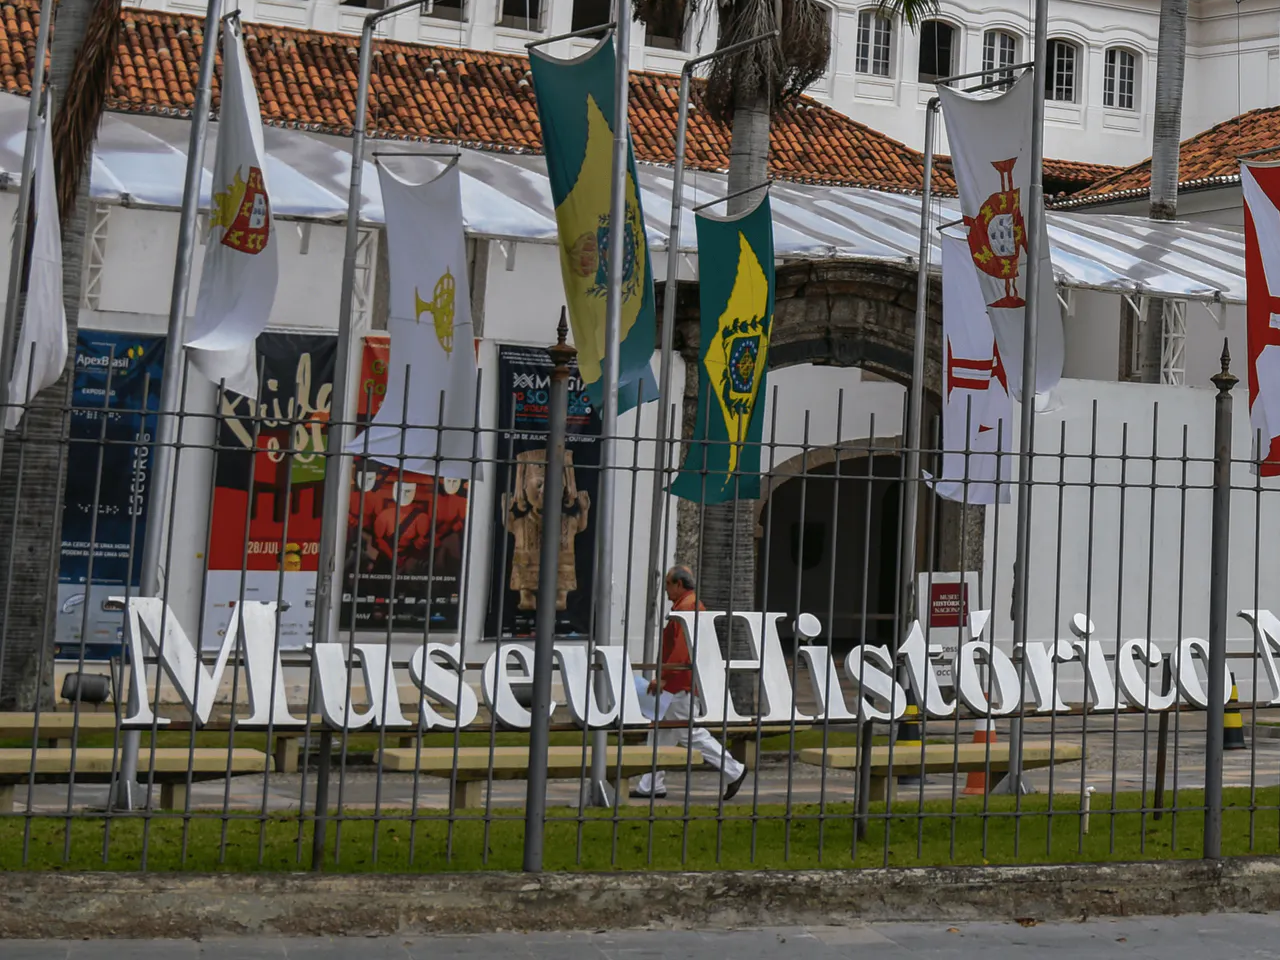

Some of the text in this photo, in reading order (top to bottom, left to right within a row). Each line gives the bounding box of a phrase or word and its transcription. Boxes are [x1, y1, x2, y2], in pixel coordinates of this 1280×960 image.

[76, 354, 129, 369] ApexBasil
[107, 596, 651, 730] Museu
[668, 610, 1232, 724] Histórico
